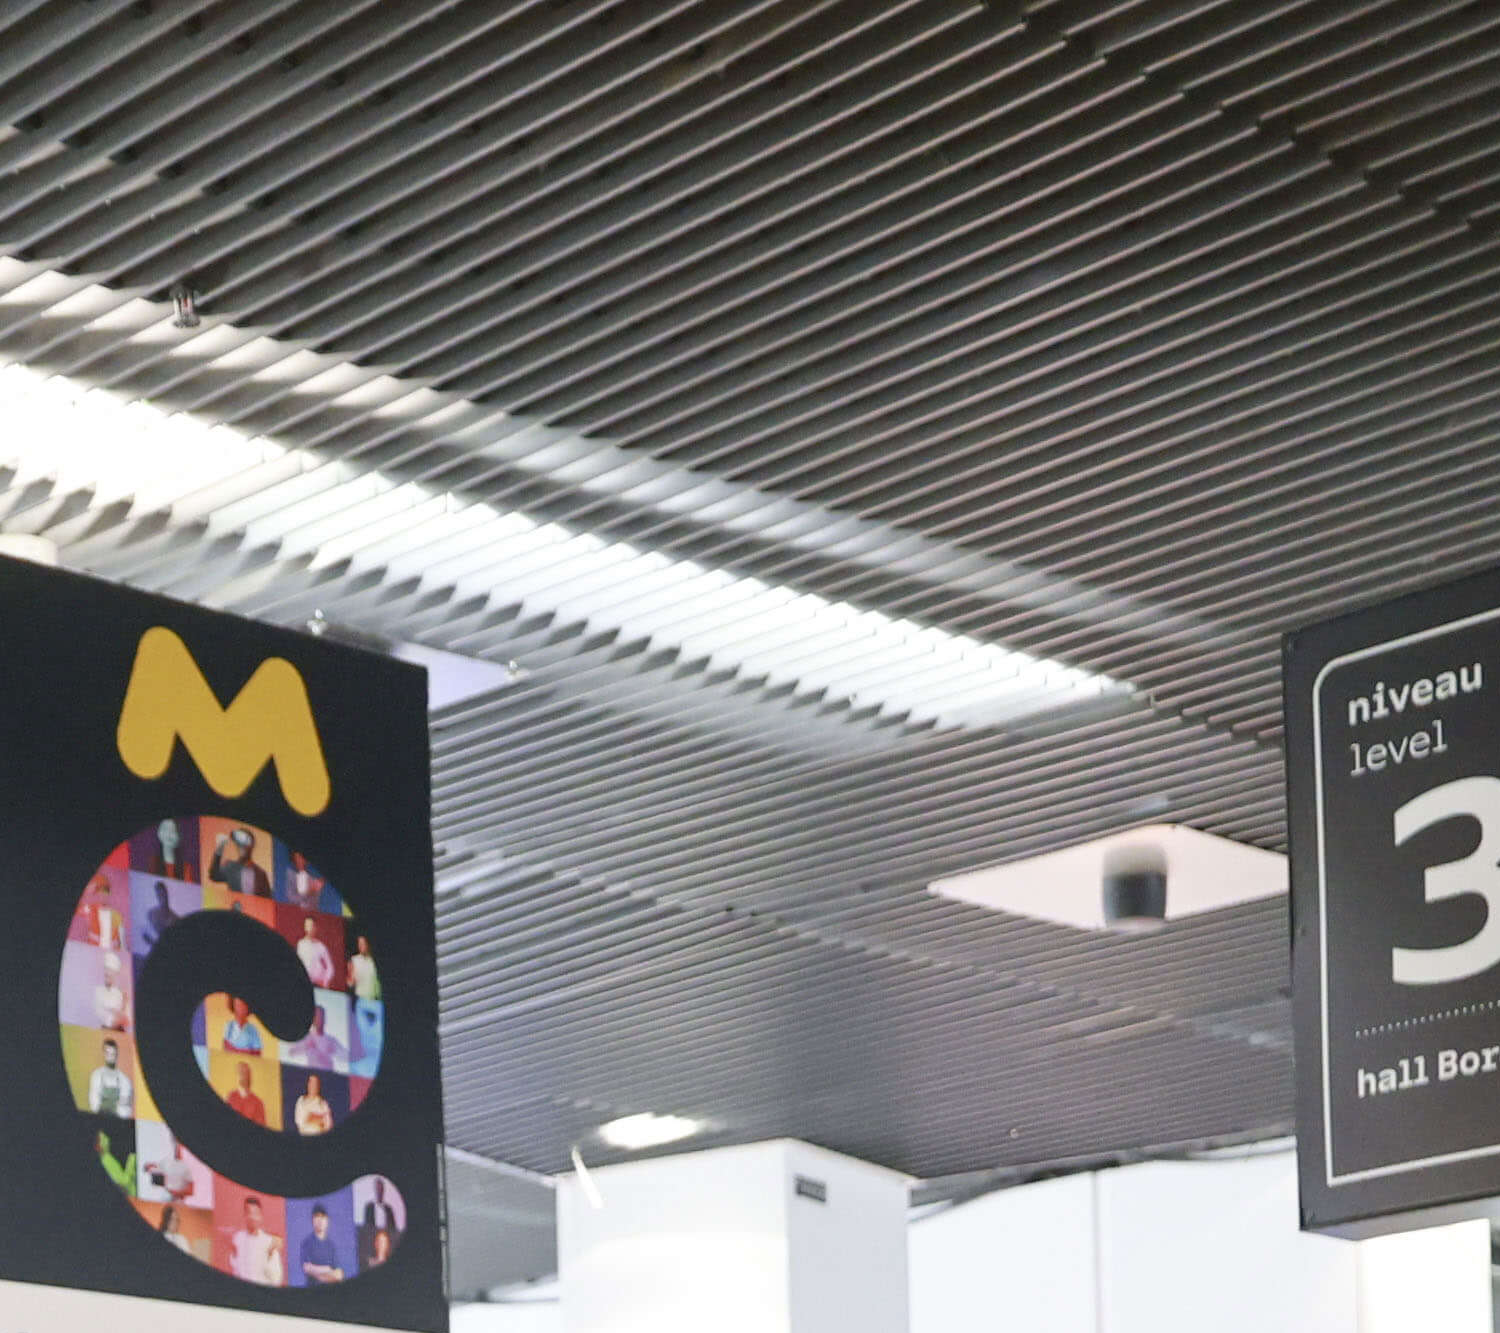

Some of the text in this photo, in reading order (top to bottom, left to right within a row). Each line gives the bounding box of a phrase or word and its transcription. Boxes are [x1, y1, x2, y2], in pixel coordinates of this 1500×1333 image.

[1348, 662, 1482, 726] niveau
[1350, 719, 1448, 776] level
[1357, 1056, 1430, 1099] hall
